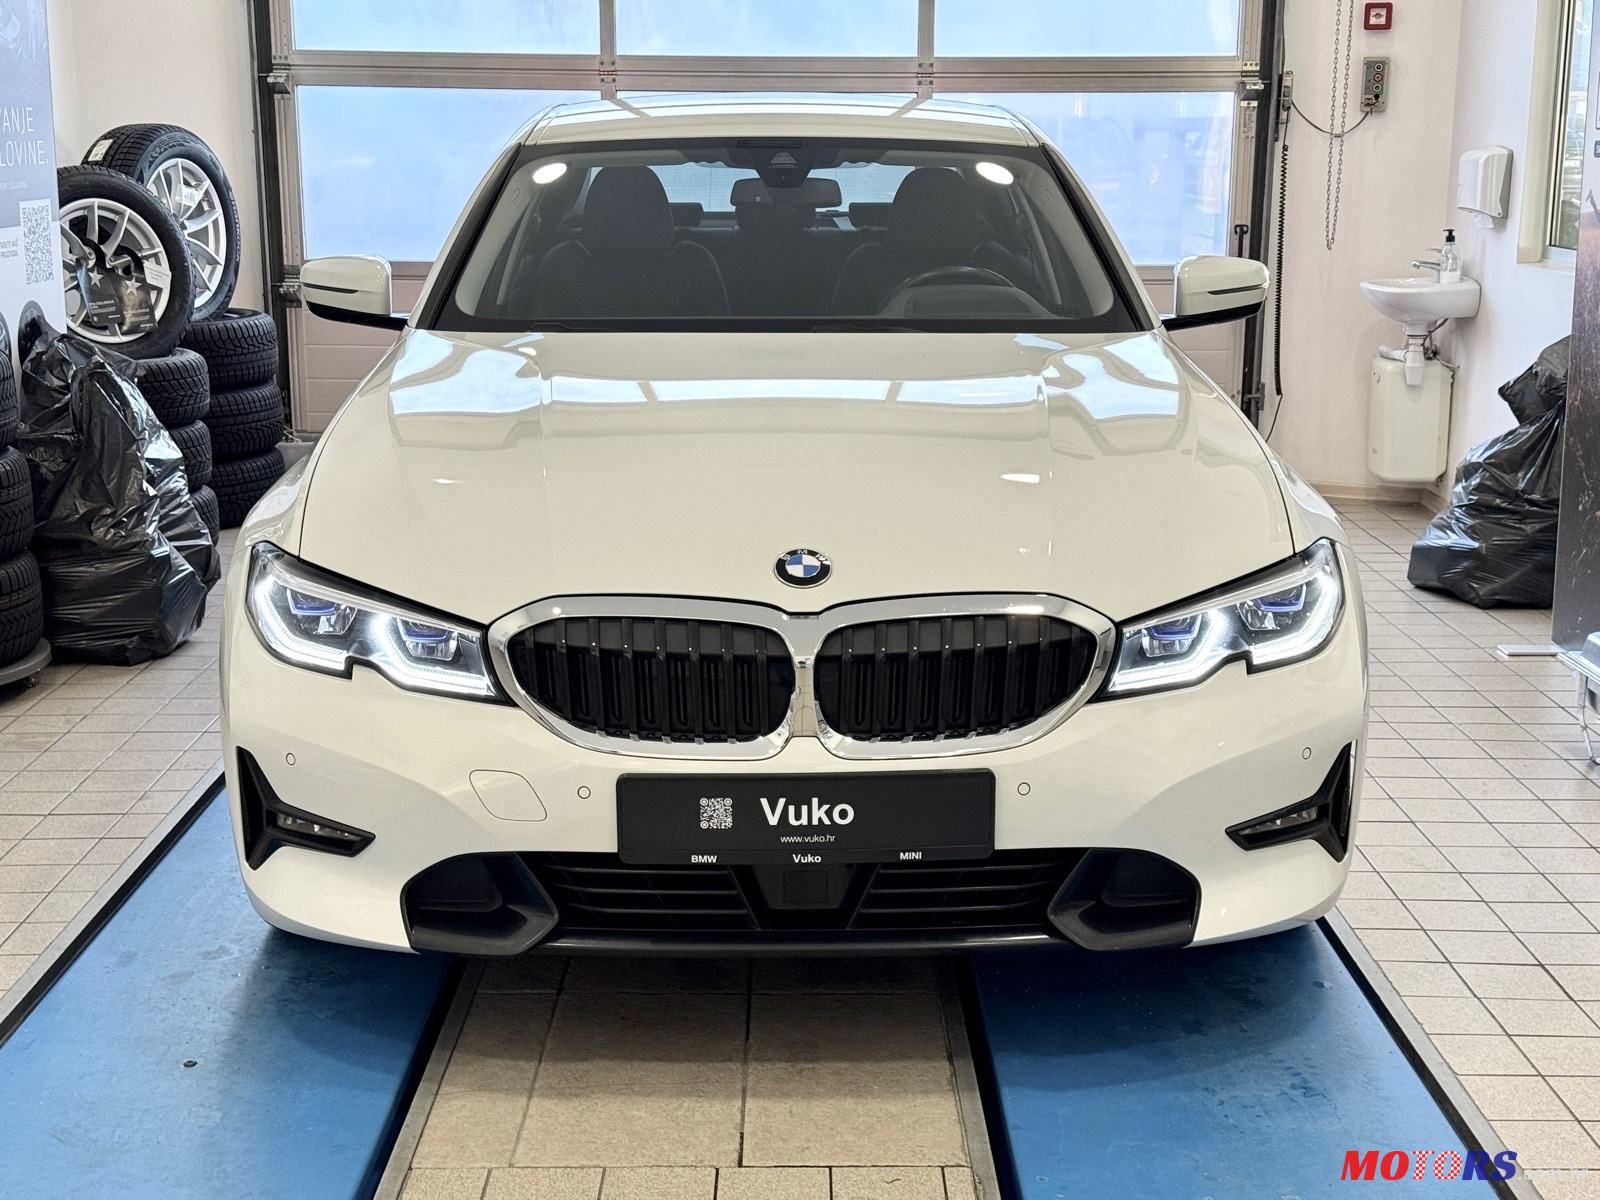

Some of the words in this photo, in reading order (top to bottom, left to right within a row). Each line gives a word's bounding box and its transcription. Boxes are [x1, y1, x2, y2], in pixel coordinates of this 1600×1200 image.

[0, 107, 34, 134] ANJE
[760, 797, 855, 825] Vuko
[780, 833, 836, 843] www.vuko.hr
[691, 854, 718, 864] BMW
[792, 853, 822, 864] Vuko
[900, 851, 923, 861] MINI
